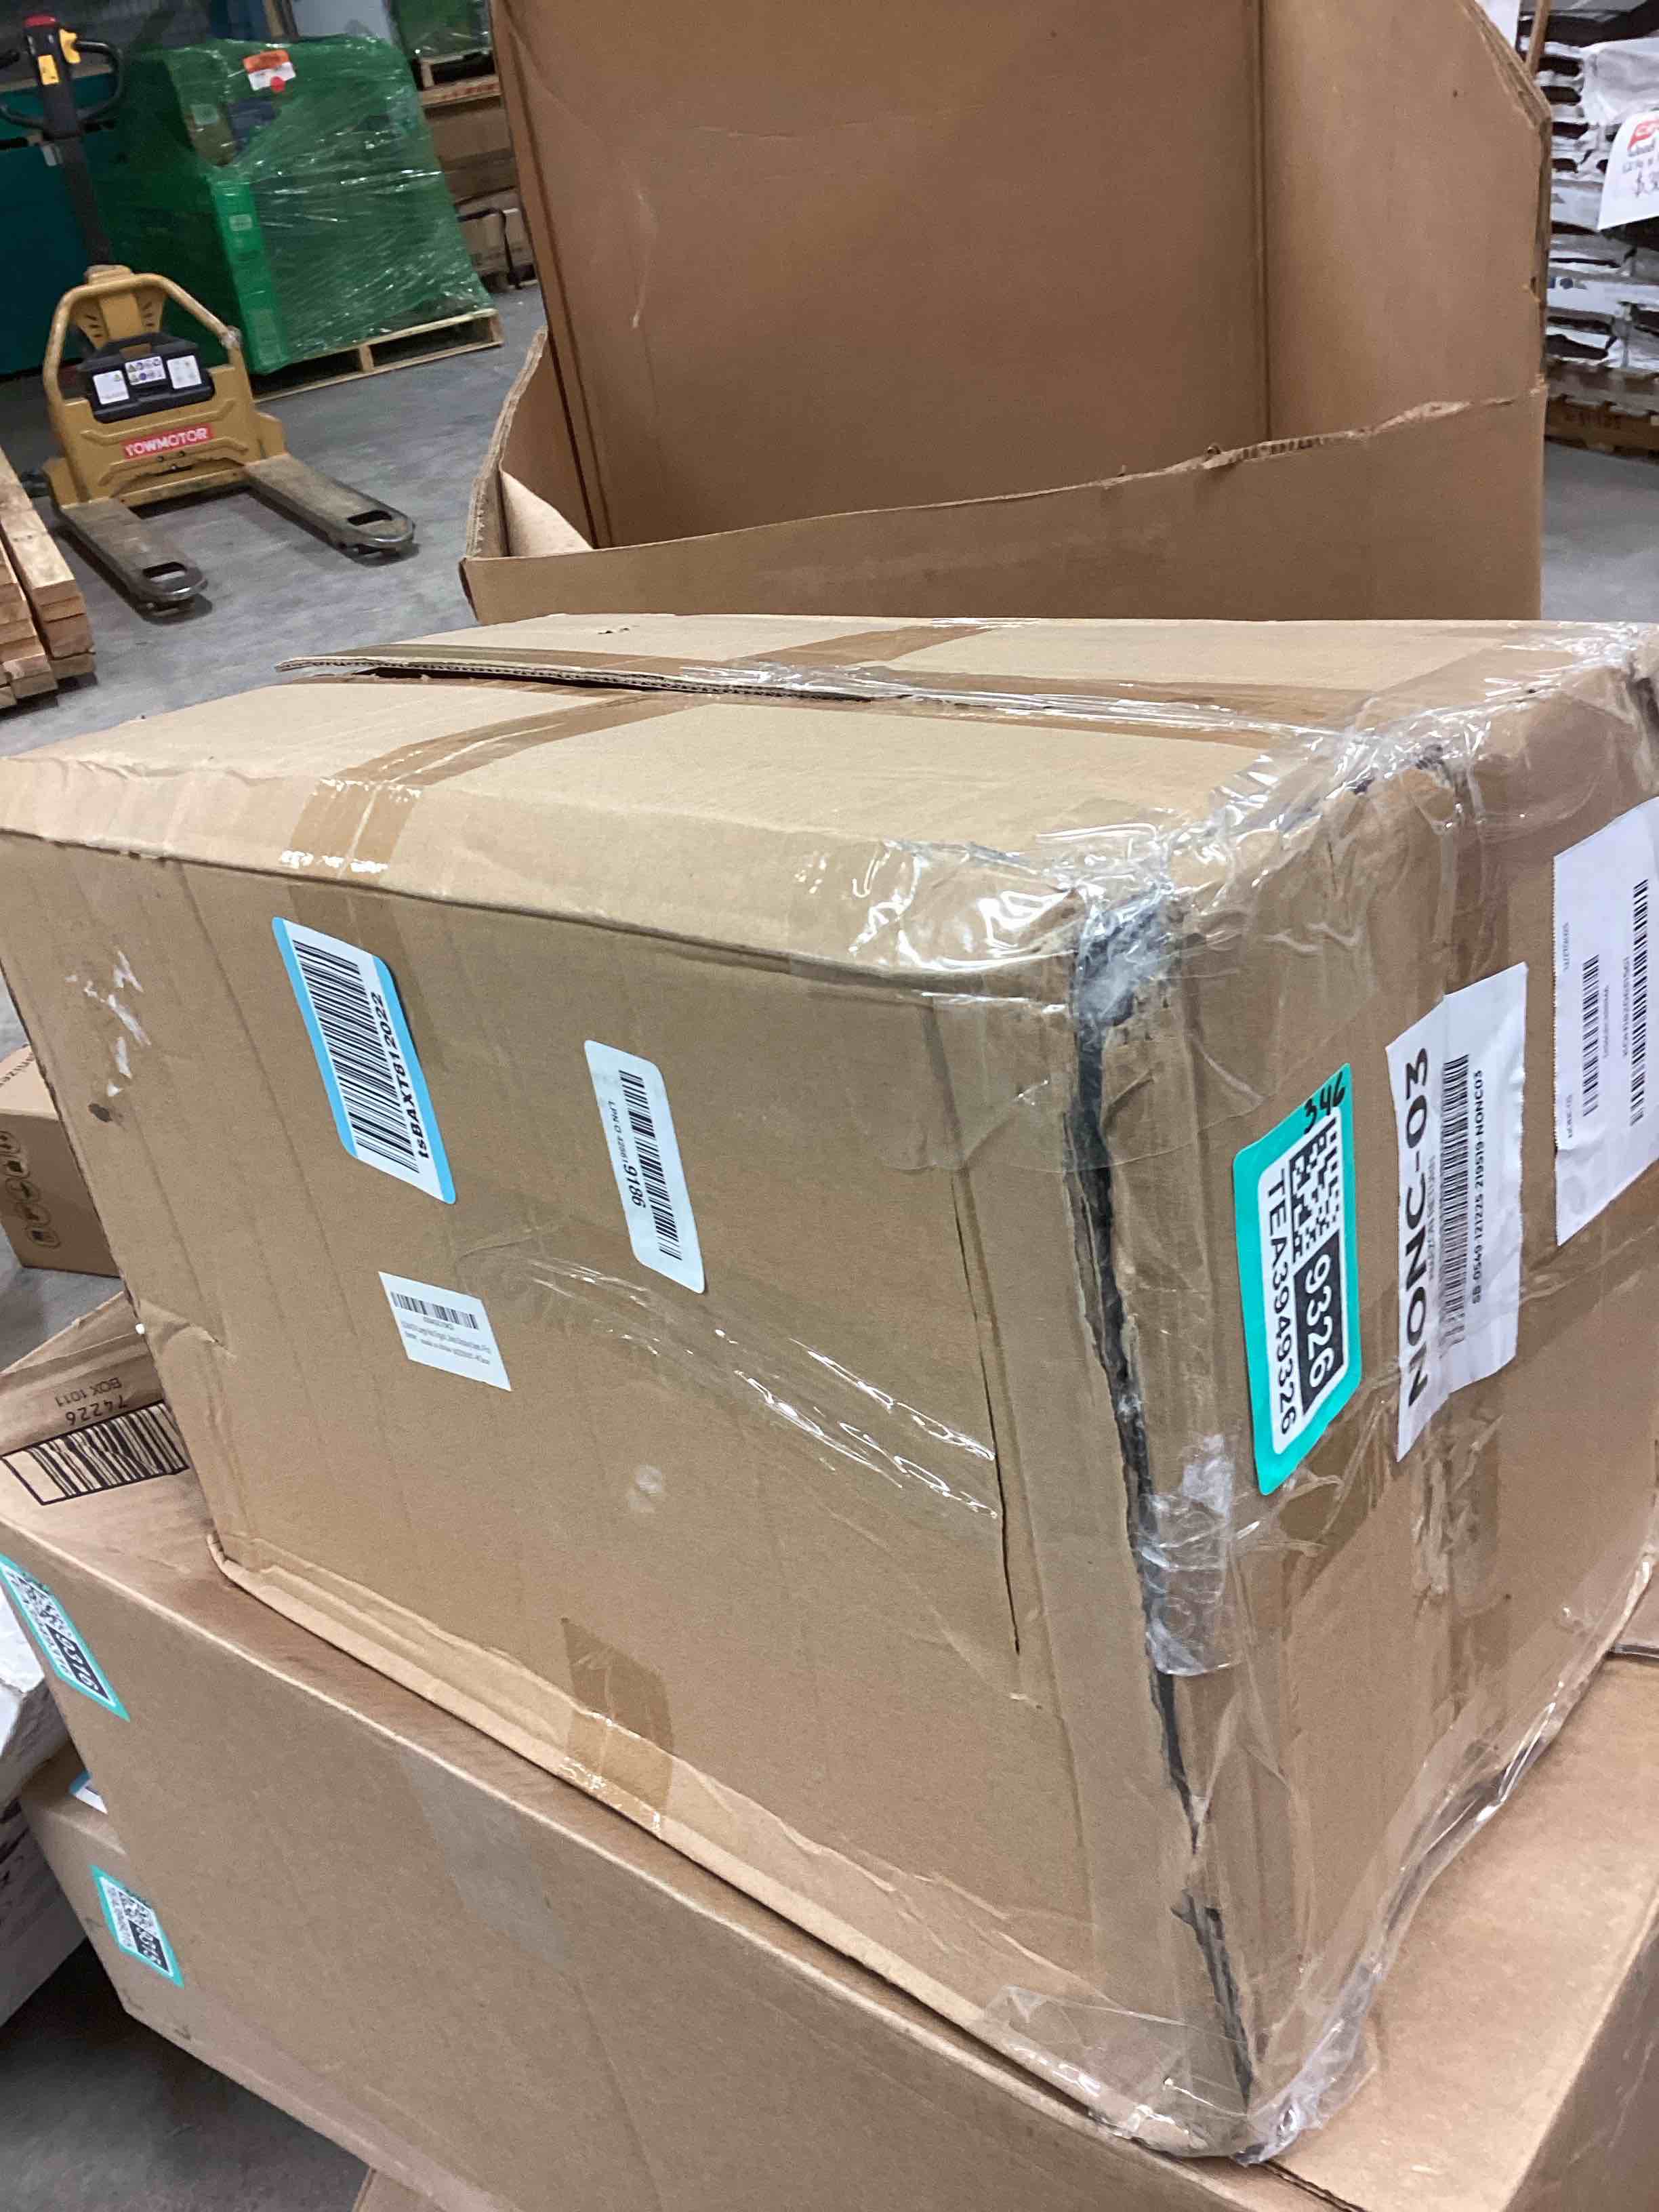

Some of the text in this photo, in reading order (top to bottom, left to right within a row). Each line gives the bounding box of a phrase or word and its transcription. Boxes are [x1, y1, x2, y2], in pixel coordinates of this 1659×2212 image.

[125, 427, 207, 457] TOWMOTOR
[1406, 1048, 1428, 1408] NONC-03
[1267, 1168, 1296, 1435] TEA3949326
[1305, 1254, 1334, 1388] 9326
[65, 1395, 127, 1426] 74226
[89, 1377, 122, 1396] BOX
